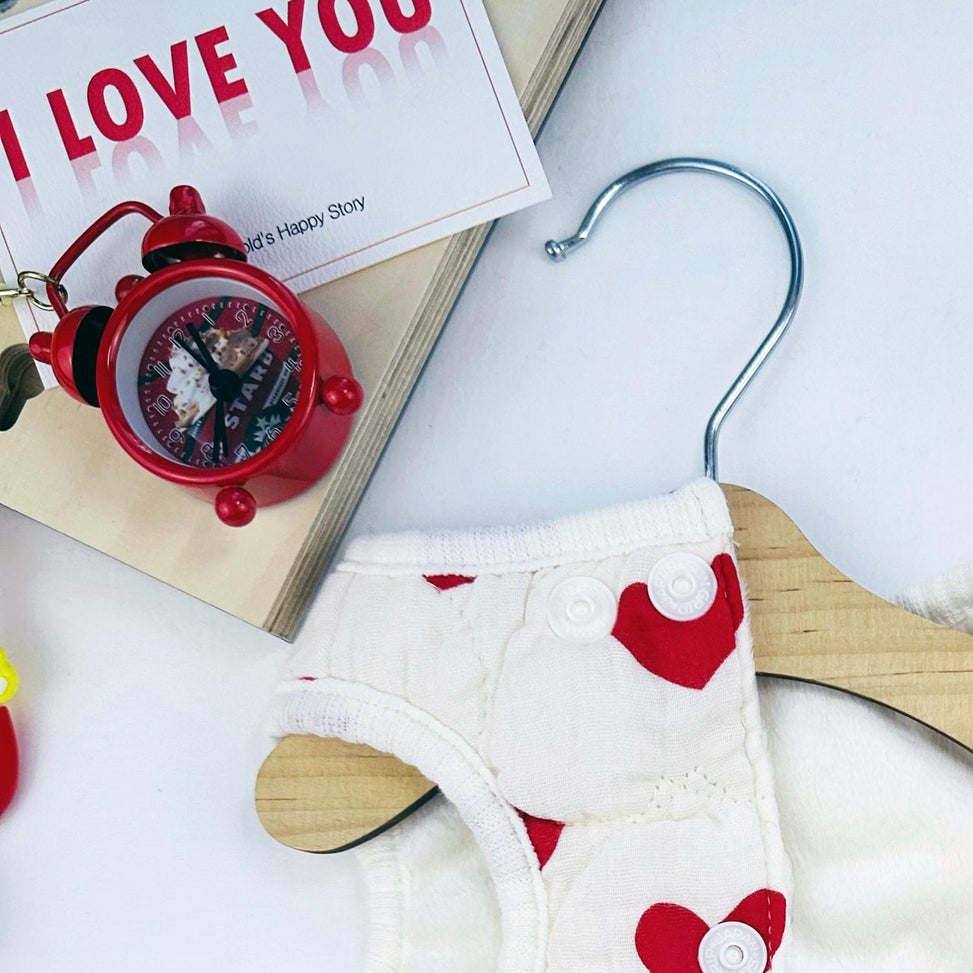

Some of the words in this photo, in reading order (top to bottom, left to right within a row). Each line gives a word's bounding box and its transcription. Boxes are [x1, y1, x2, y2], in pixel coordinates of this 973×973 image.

[0, 109, 31, 182] I
[46, 25, 248, 161] LOVE
[276, 212, 324, 240] Happy
[327, 196, 365, 220] Story
[202, 312, 215, 326] 1
[235, 309, 253, 328] 2
[267, 325, 284, 343] 3
[153, 361, 172, 378] 11
[153, 395, 173, 416] 10
[169, 429, 185, 443] 9
